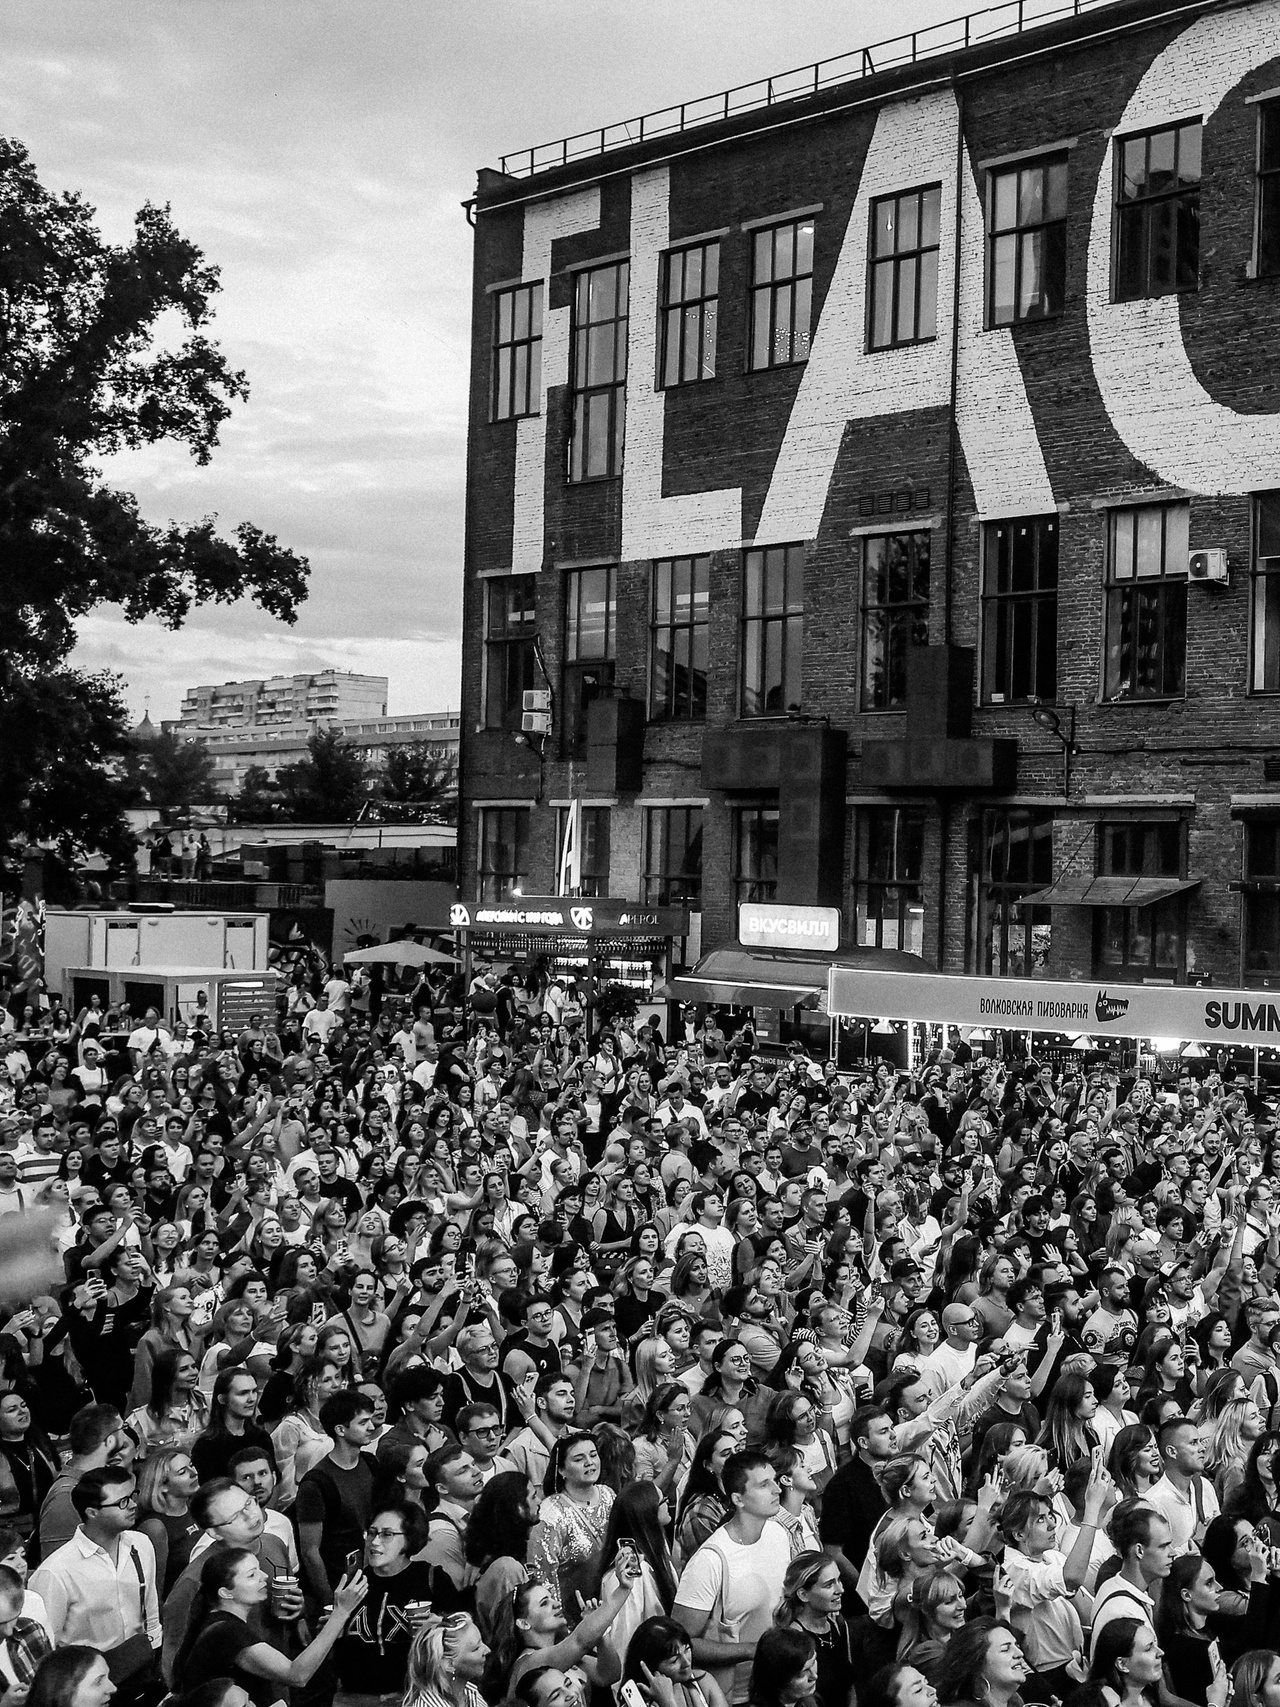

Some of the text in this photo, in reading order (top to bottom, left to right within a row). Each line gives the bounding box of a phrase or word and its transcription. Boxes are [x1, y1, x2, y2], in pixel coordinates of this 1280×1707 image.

[619, 913, 659, 926] APEROL
[748, 918, 829, 937] ВКУСВИЛЛ
[980, 998, 1088, 1019] ВОЛКОВСКАЯ ПИВОВАРНЯ
